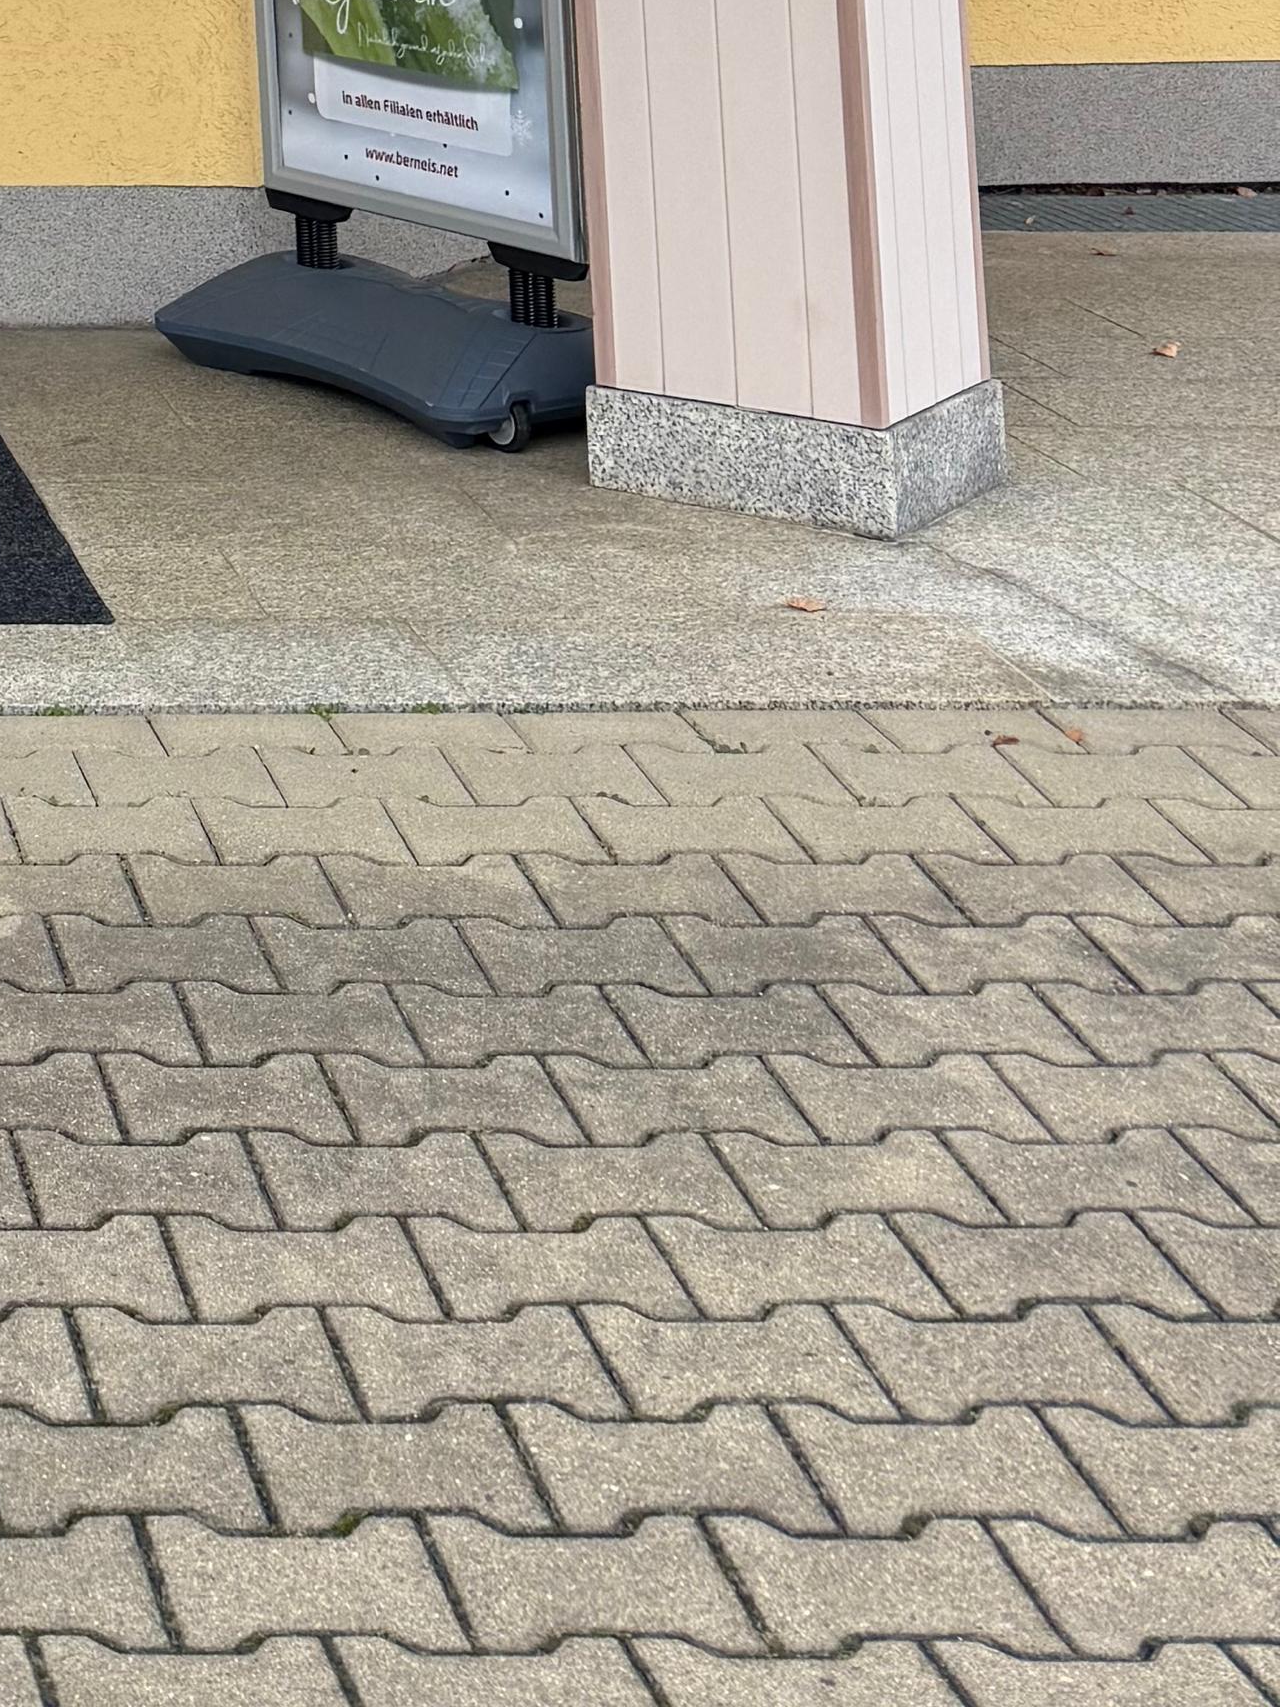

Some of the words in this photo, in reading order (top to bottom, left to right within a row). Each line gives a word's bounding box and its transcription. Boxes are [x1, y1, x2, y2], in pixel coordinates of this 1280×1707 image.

[342, 90, 353, 105] In
[354, 94, 381, 111] allen
[383, 99, 423, 120] Filialen
[425, 109, 479, 132] erhältlich
[365, 147, 459, 179] www.berneis.net
